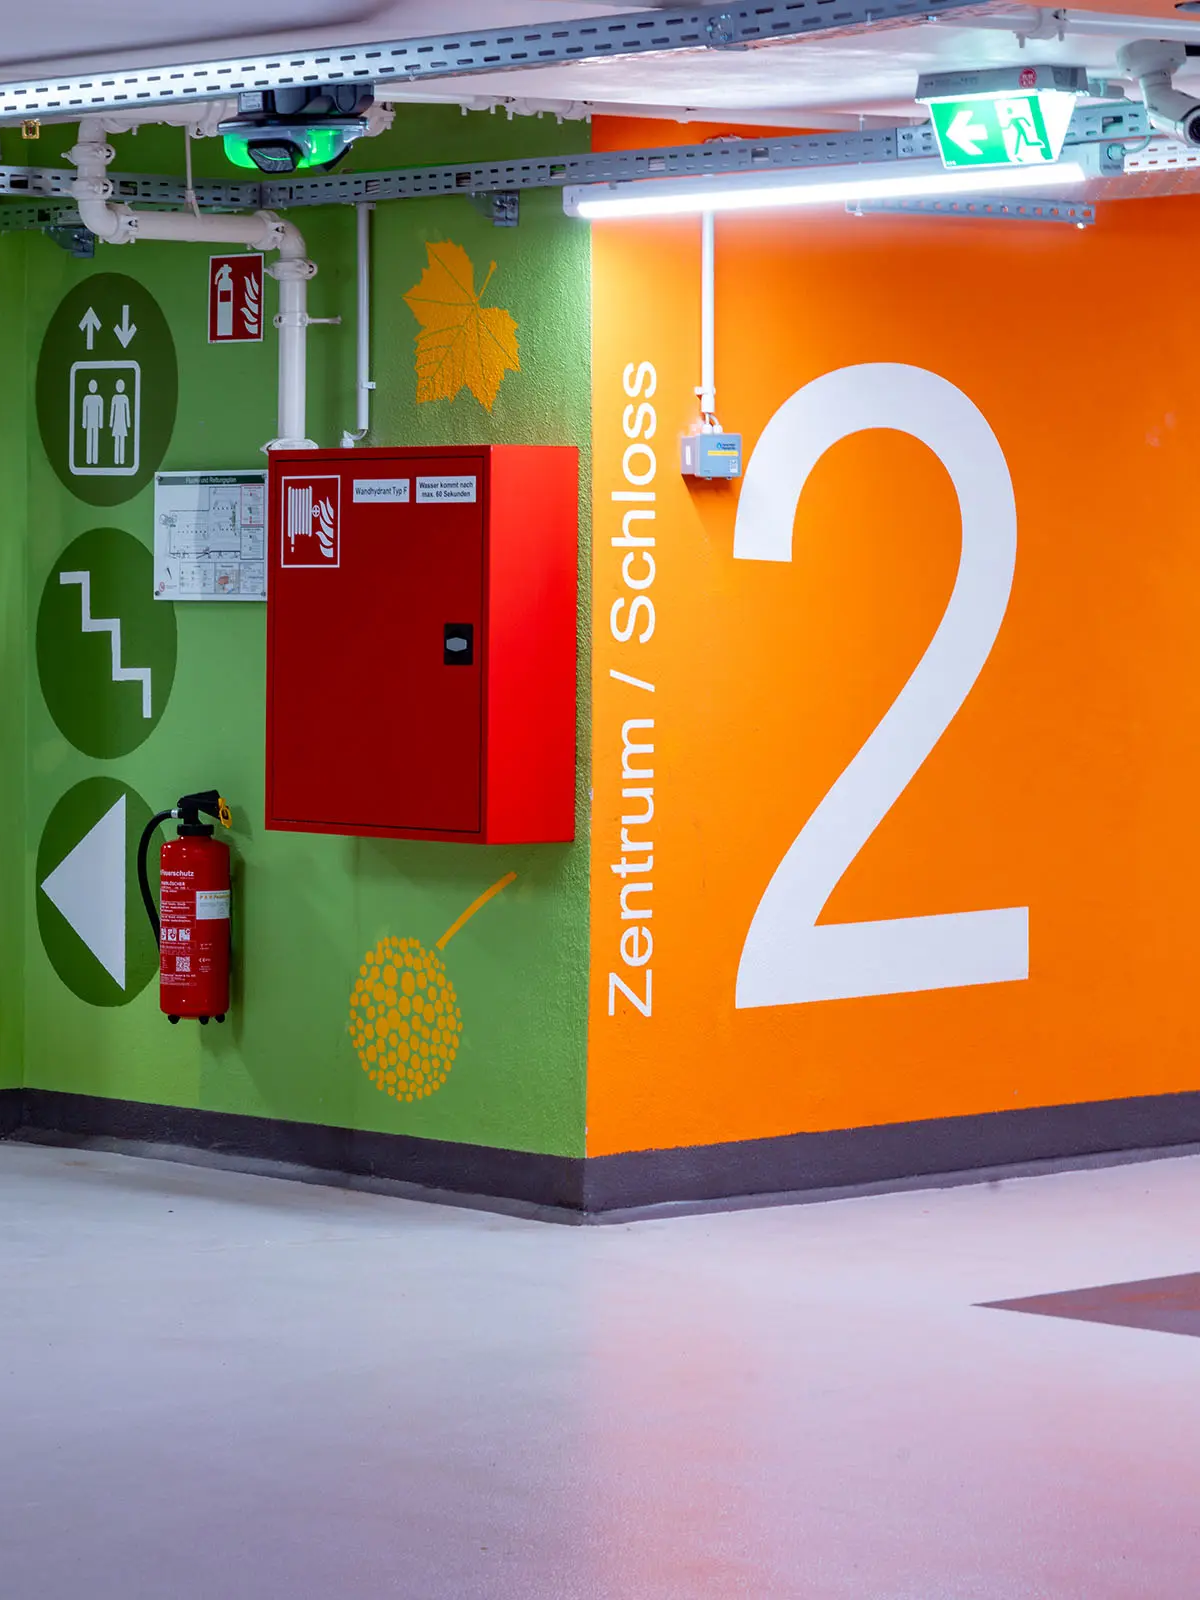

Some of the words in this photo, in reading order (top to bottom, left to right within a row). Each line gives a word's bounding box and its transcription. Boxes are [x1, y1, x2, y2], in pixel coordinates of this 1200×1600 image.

[355, 487, 392, 497] Wandhydrant
[393, 486, 403, 497] Typ
[403, 486, 408, 495] F
[419, 481, 439, 489] Wasser
[440, 480, 459, 488] kommt
[460, 480, 474, 488] nach
[443, 489, 471, 498] Sekunden
[609, 360, 658, 644] Schloss
[609, 669, 655, 693] /
[732, 361, 1030, 1010] 2
[608, 718, 655, 1018] Zentrum
